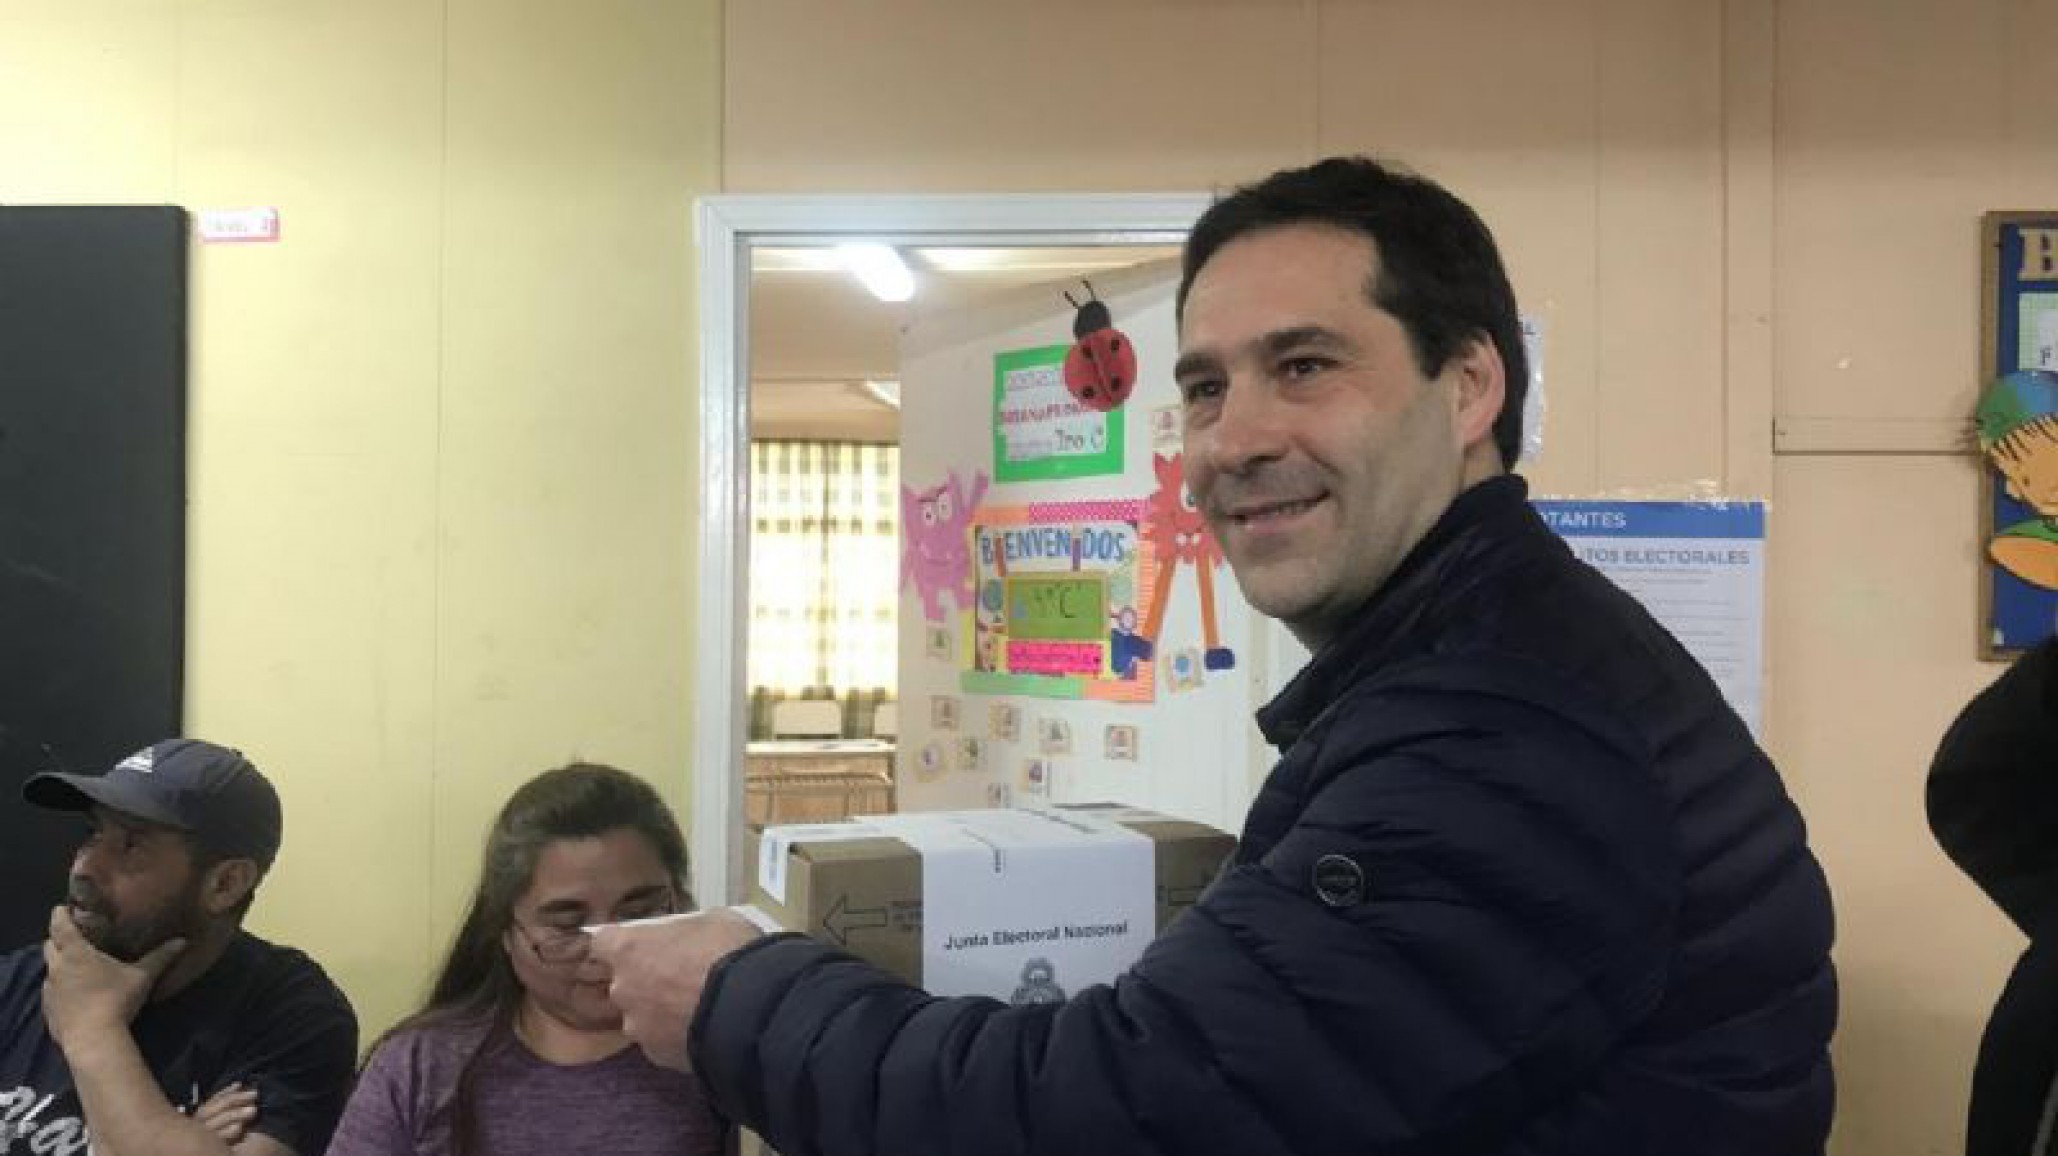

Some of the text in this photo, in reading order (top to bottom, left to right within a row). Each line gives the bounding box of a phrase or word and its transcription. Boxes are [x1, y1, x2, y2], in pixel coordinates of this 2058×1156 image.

[1540, 511, 1627, 528] TANTES
[982, 527, 1125, 576] BIENVENIDOS
[1626, 550, 1750, 564] ELECTORALES
[944, 919, 1128, 950] Junta Electoral Nacional
